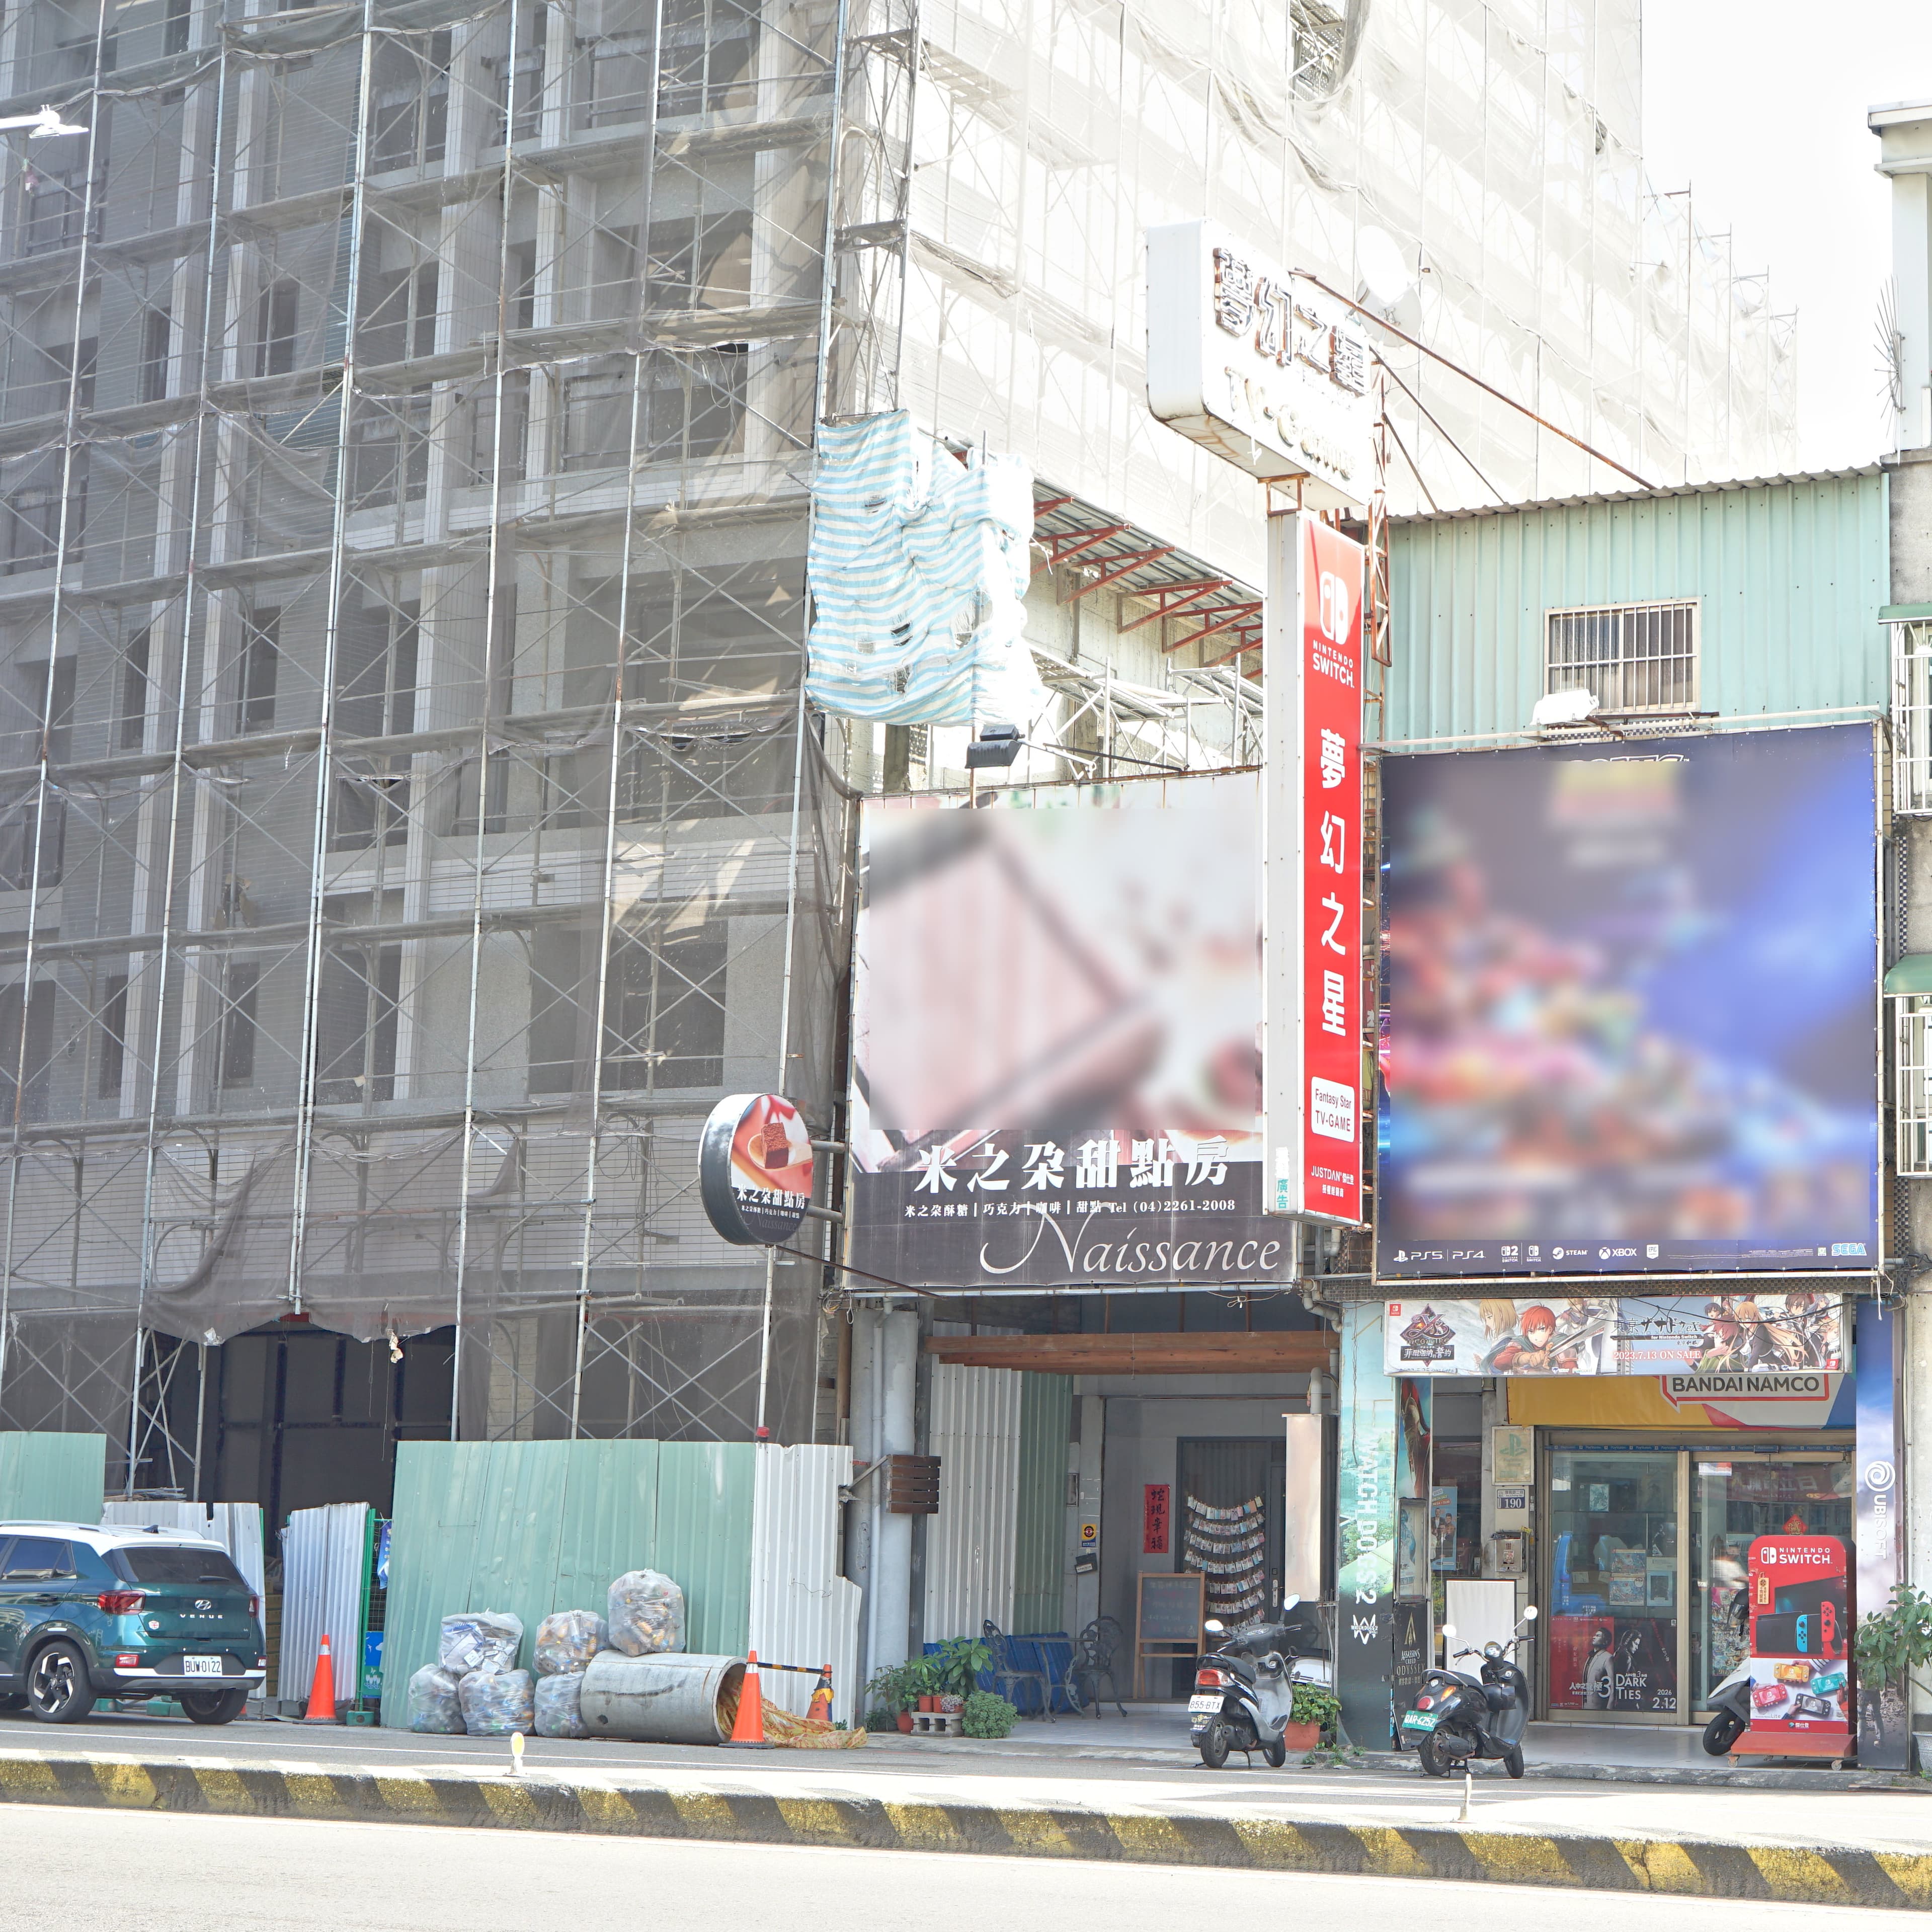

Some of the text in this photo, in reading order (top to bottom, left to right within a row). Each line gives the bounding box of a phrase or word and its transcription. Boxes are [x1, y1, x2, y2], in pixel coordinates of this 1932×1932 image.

[1313, 639, 1353, 668] NINTENDO
[1313, 654, 1353, 688] SWITCH
[1320, 728, 1346, 1037] 夢幻之星
[1315, 1088, 1338, 1108] Fantasy
[1340, 1095, 1351, 1109] Star
[1315, 1110, 1350, 1132] TV-GAME
[914, 1135, 1228, 1193] 米之朵甜點房
[1342, 1173, 1354, 1185] 傑仕登
[737, 1184, 806, 1210] 米之朵甜點房
[1276, 1178, 1289, 1209] 廣告
[905, 1199, 1235, 1218] 米之朵酥糖 巧克力 咖啡 甜點 Tel (04)2261-2008
[980, 1203, 1280, 1274] Naissance
[1411, 1250, 1442, 1260] PS5
[1453, 1250, 1485, 1260] PS4
[1612, 1248, 1637, 1257] XBOX
[1832, 1243, 1867, 1256] SEGA
[1614, 1350, 1701, 1359] 2023.7.13 ON SALE
[1673, 1376, 1820, 1392] BANDAI NAMCO
[1505, 1498, 1522, 1508] 190
[1874, 1494, 1887, 1560] UBISOFT
[1779, 1554, 1830, 1564] SWITCH
[1356, 1586, 1377, 1604] 2
[185, 1661, 221, 1672] BUW-0122
[1397, 1663, 1425, 1676] ODYSSEY
[1616, 1674, 1647, 1687] DARK
[1616, 1686, 1641, 1700] TIES
[1652, 1697, 1676, 1710] 2.12
